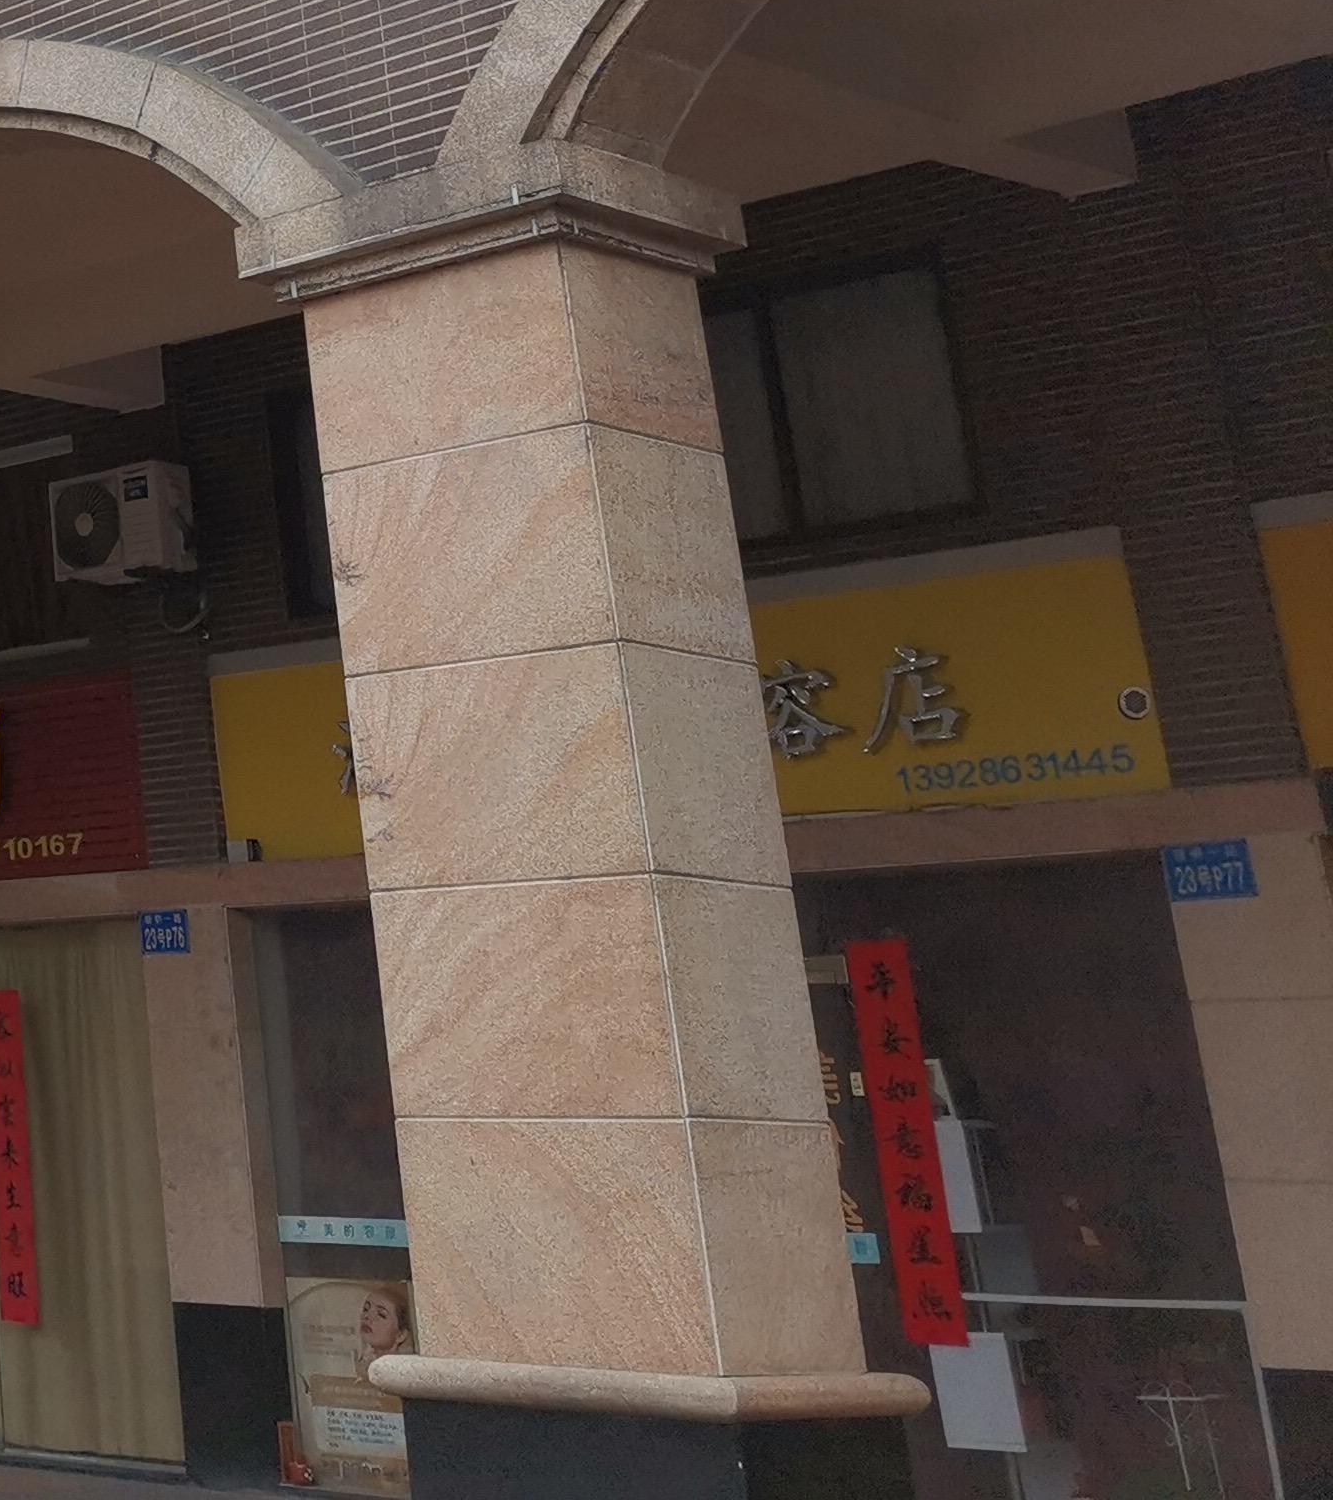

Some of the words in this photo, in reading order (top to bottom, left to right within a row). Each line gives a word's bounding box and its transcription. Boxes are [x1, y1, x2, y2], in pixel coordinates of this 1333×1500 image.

[895, 743, 1136, 793] 13928631445
[1174, 861, 1244, 895] 23号P77
[144, 925, 186, 950] 23号P76
